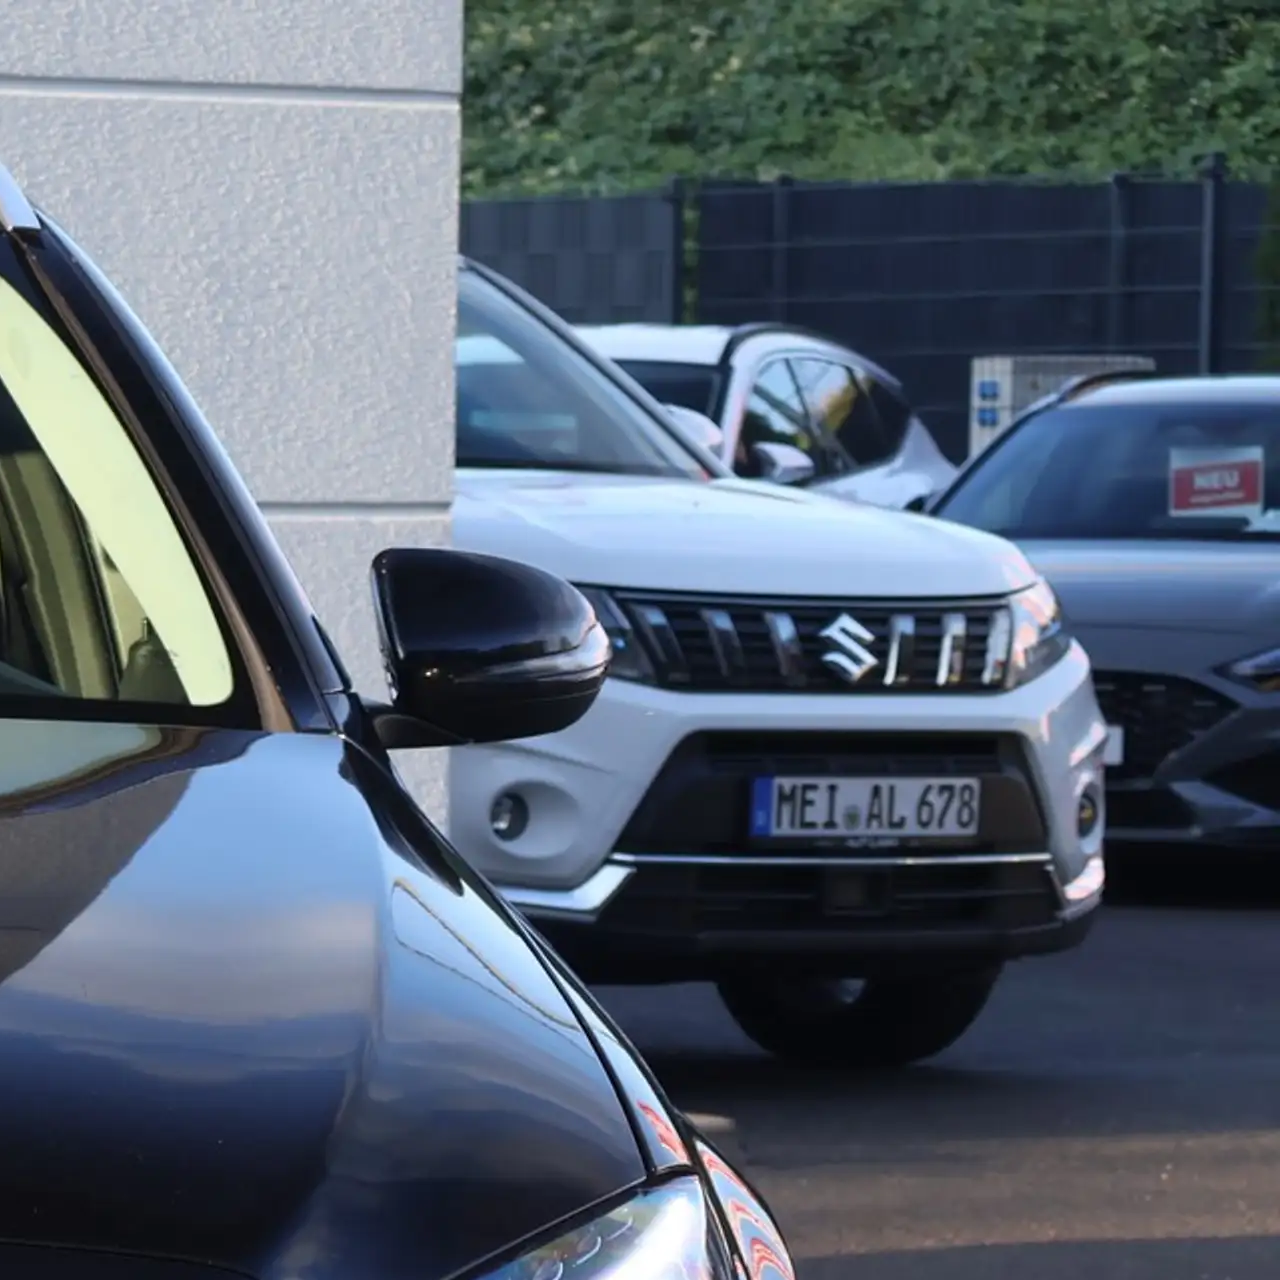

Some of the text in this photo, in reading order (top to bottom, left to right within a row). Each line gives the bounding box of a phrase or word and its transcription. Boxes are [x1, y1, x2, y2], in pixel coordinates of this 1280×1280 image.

[775, 783, 977, 829] MEI AL 678
